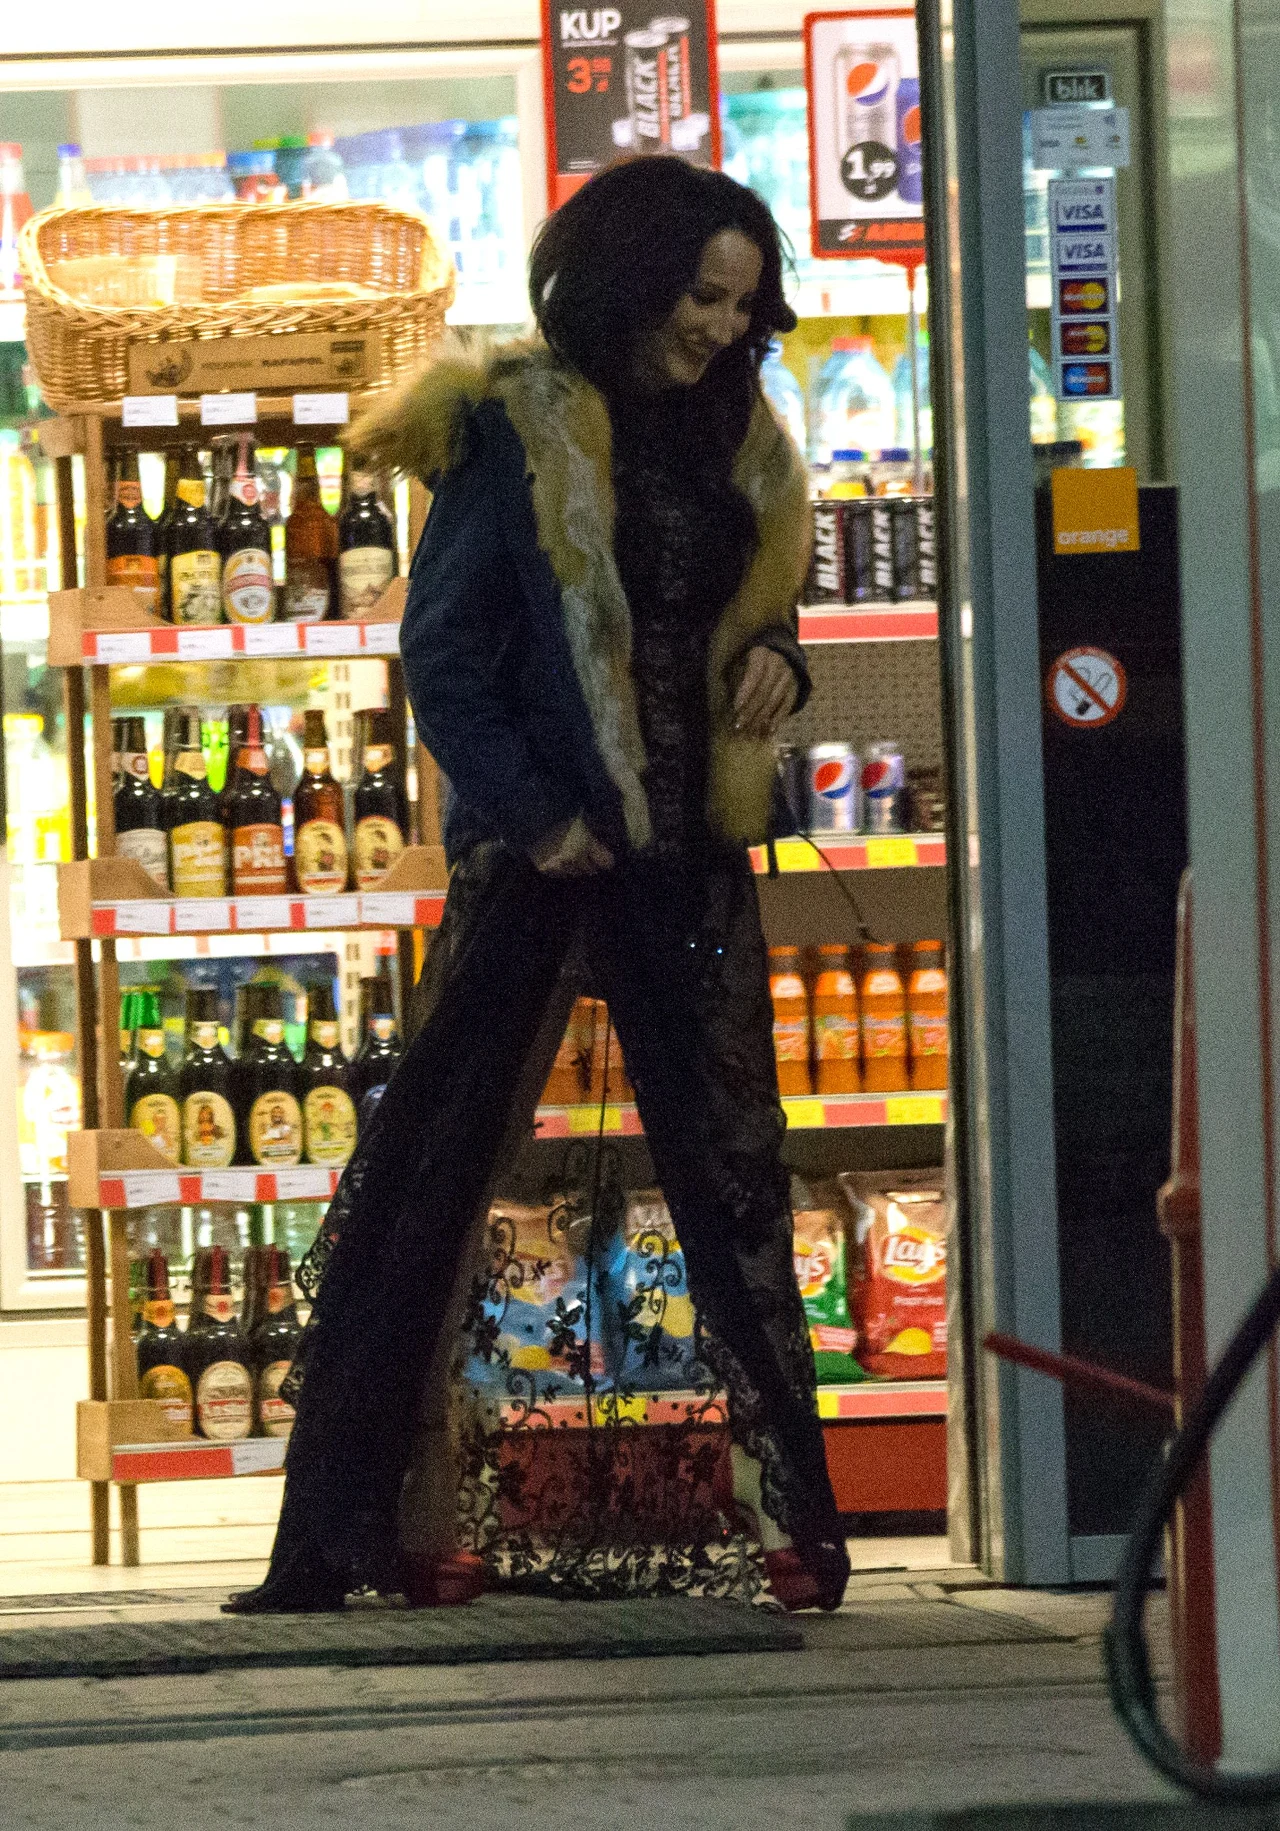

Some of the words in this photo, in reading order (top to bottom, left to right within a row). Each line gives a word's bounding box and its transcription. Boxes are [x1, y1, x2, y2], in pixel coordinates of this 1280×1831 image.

[560, 9, 621, 39] KUP
[634, 57, 660, 138] BLACK
[1055, 78, 1098, 99] blik
[1062, 204, 1104, 220] VISA
[1065, 243, 1105, 259] VISA
[814, 510, 840, 590] BLACK
[872, 508, 893, 588] BLACK
[1058, 529, 1128, 547] orange
